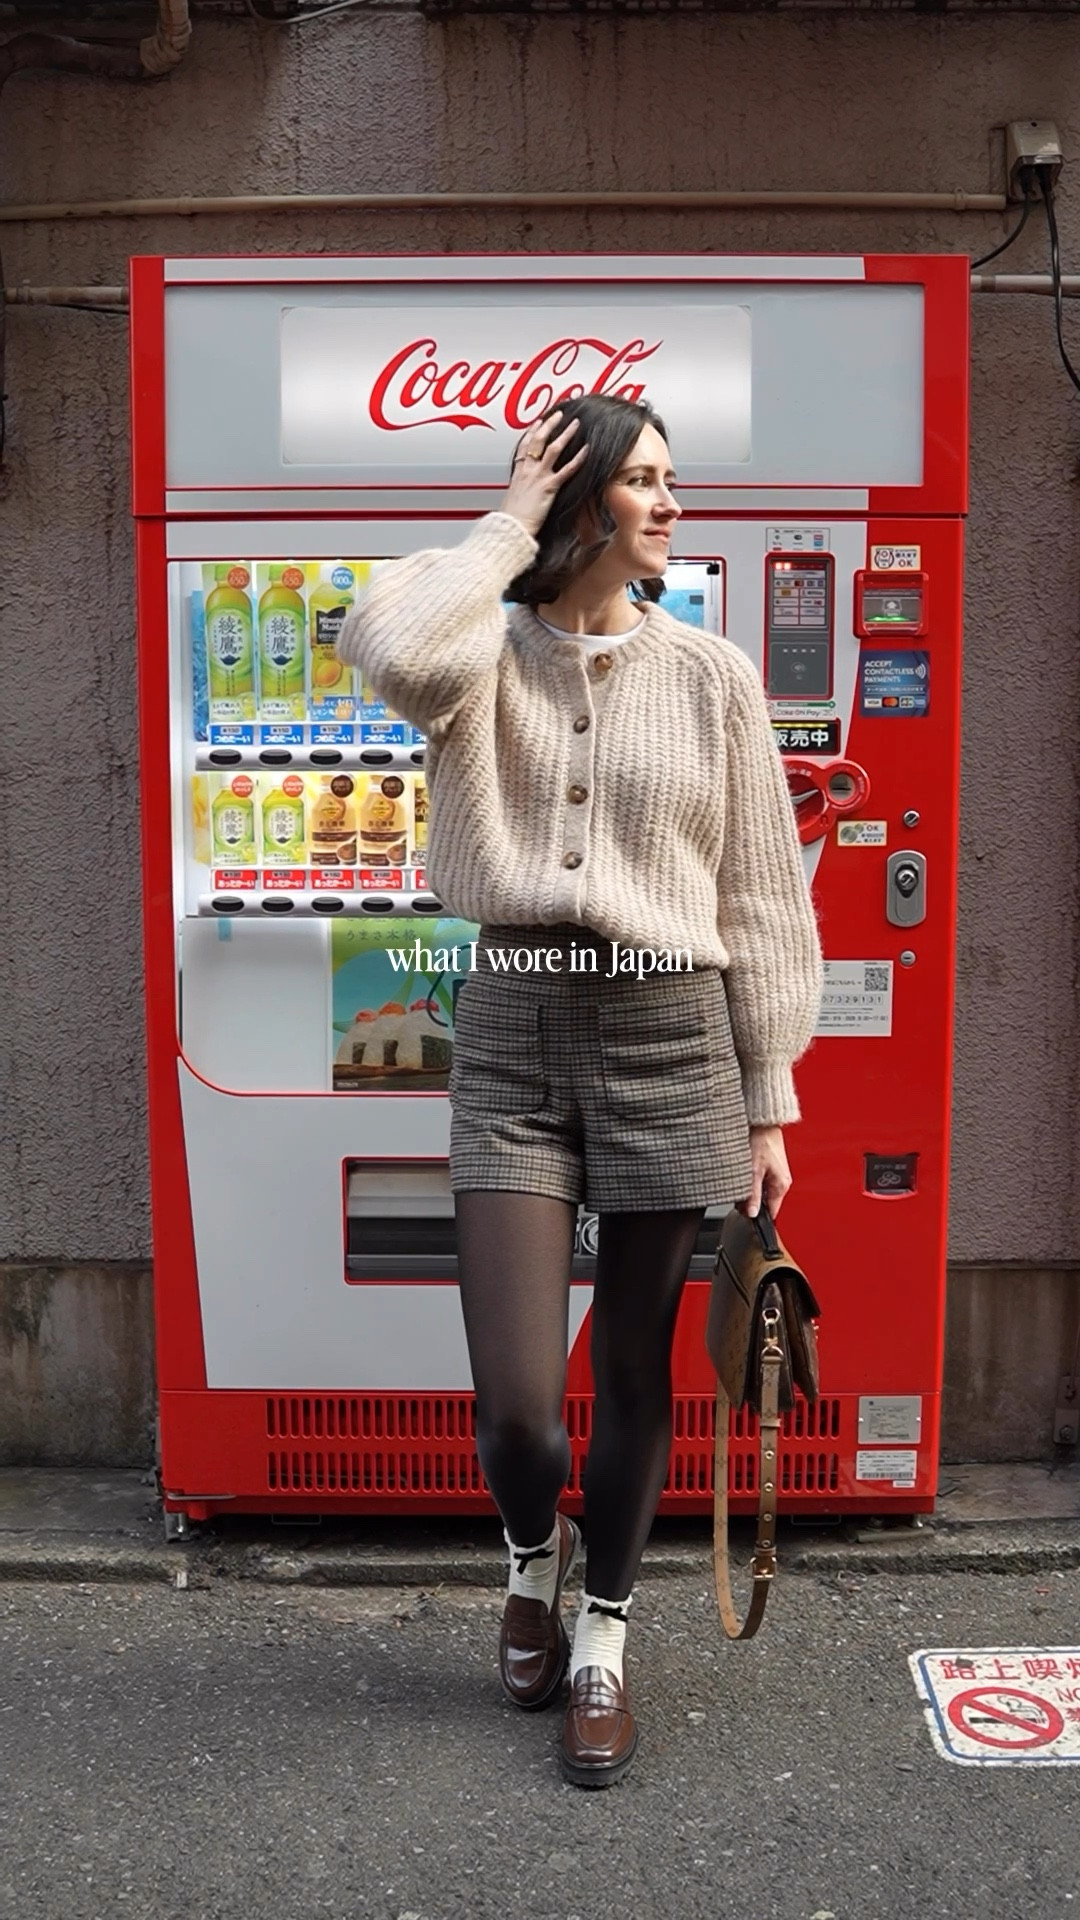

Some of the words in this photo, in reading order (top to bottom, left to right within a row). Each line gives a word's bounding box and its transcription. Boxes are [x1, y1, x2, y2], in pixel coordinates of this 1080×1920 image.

[898, 559, 913, 567] OK
[218, 616, 237, 654] 綾鷹
[271, 616, 290, 654] 綾鷹
[864, 660, 893, 668] ACCEPT
[866, 824, 879, 832] OK
